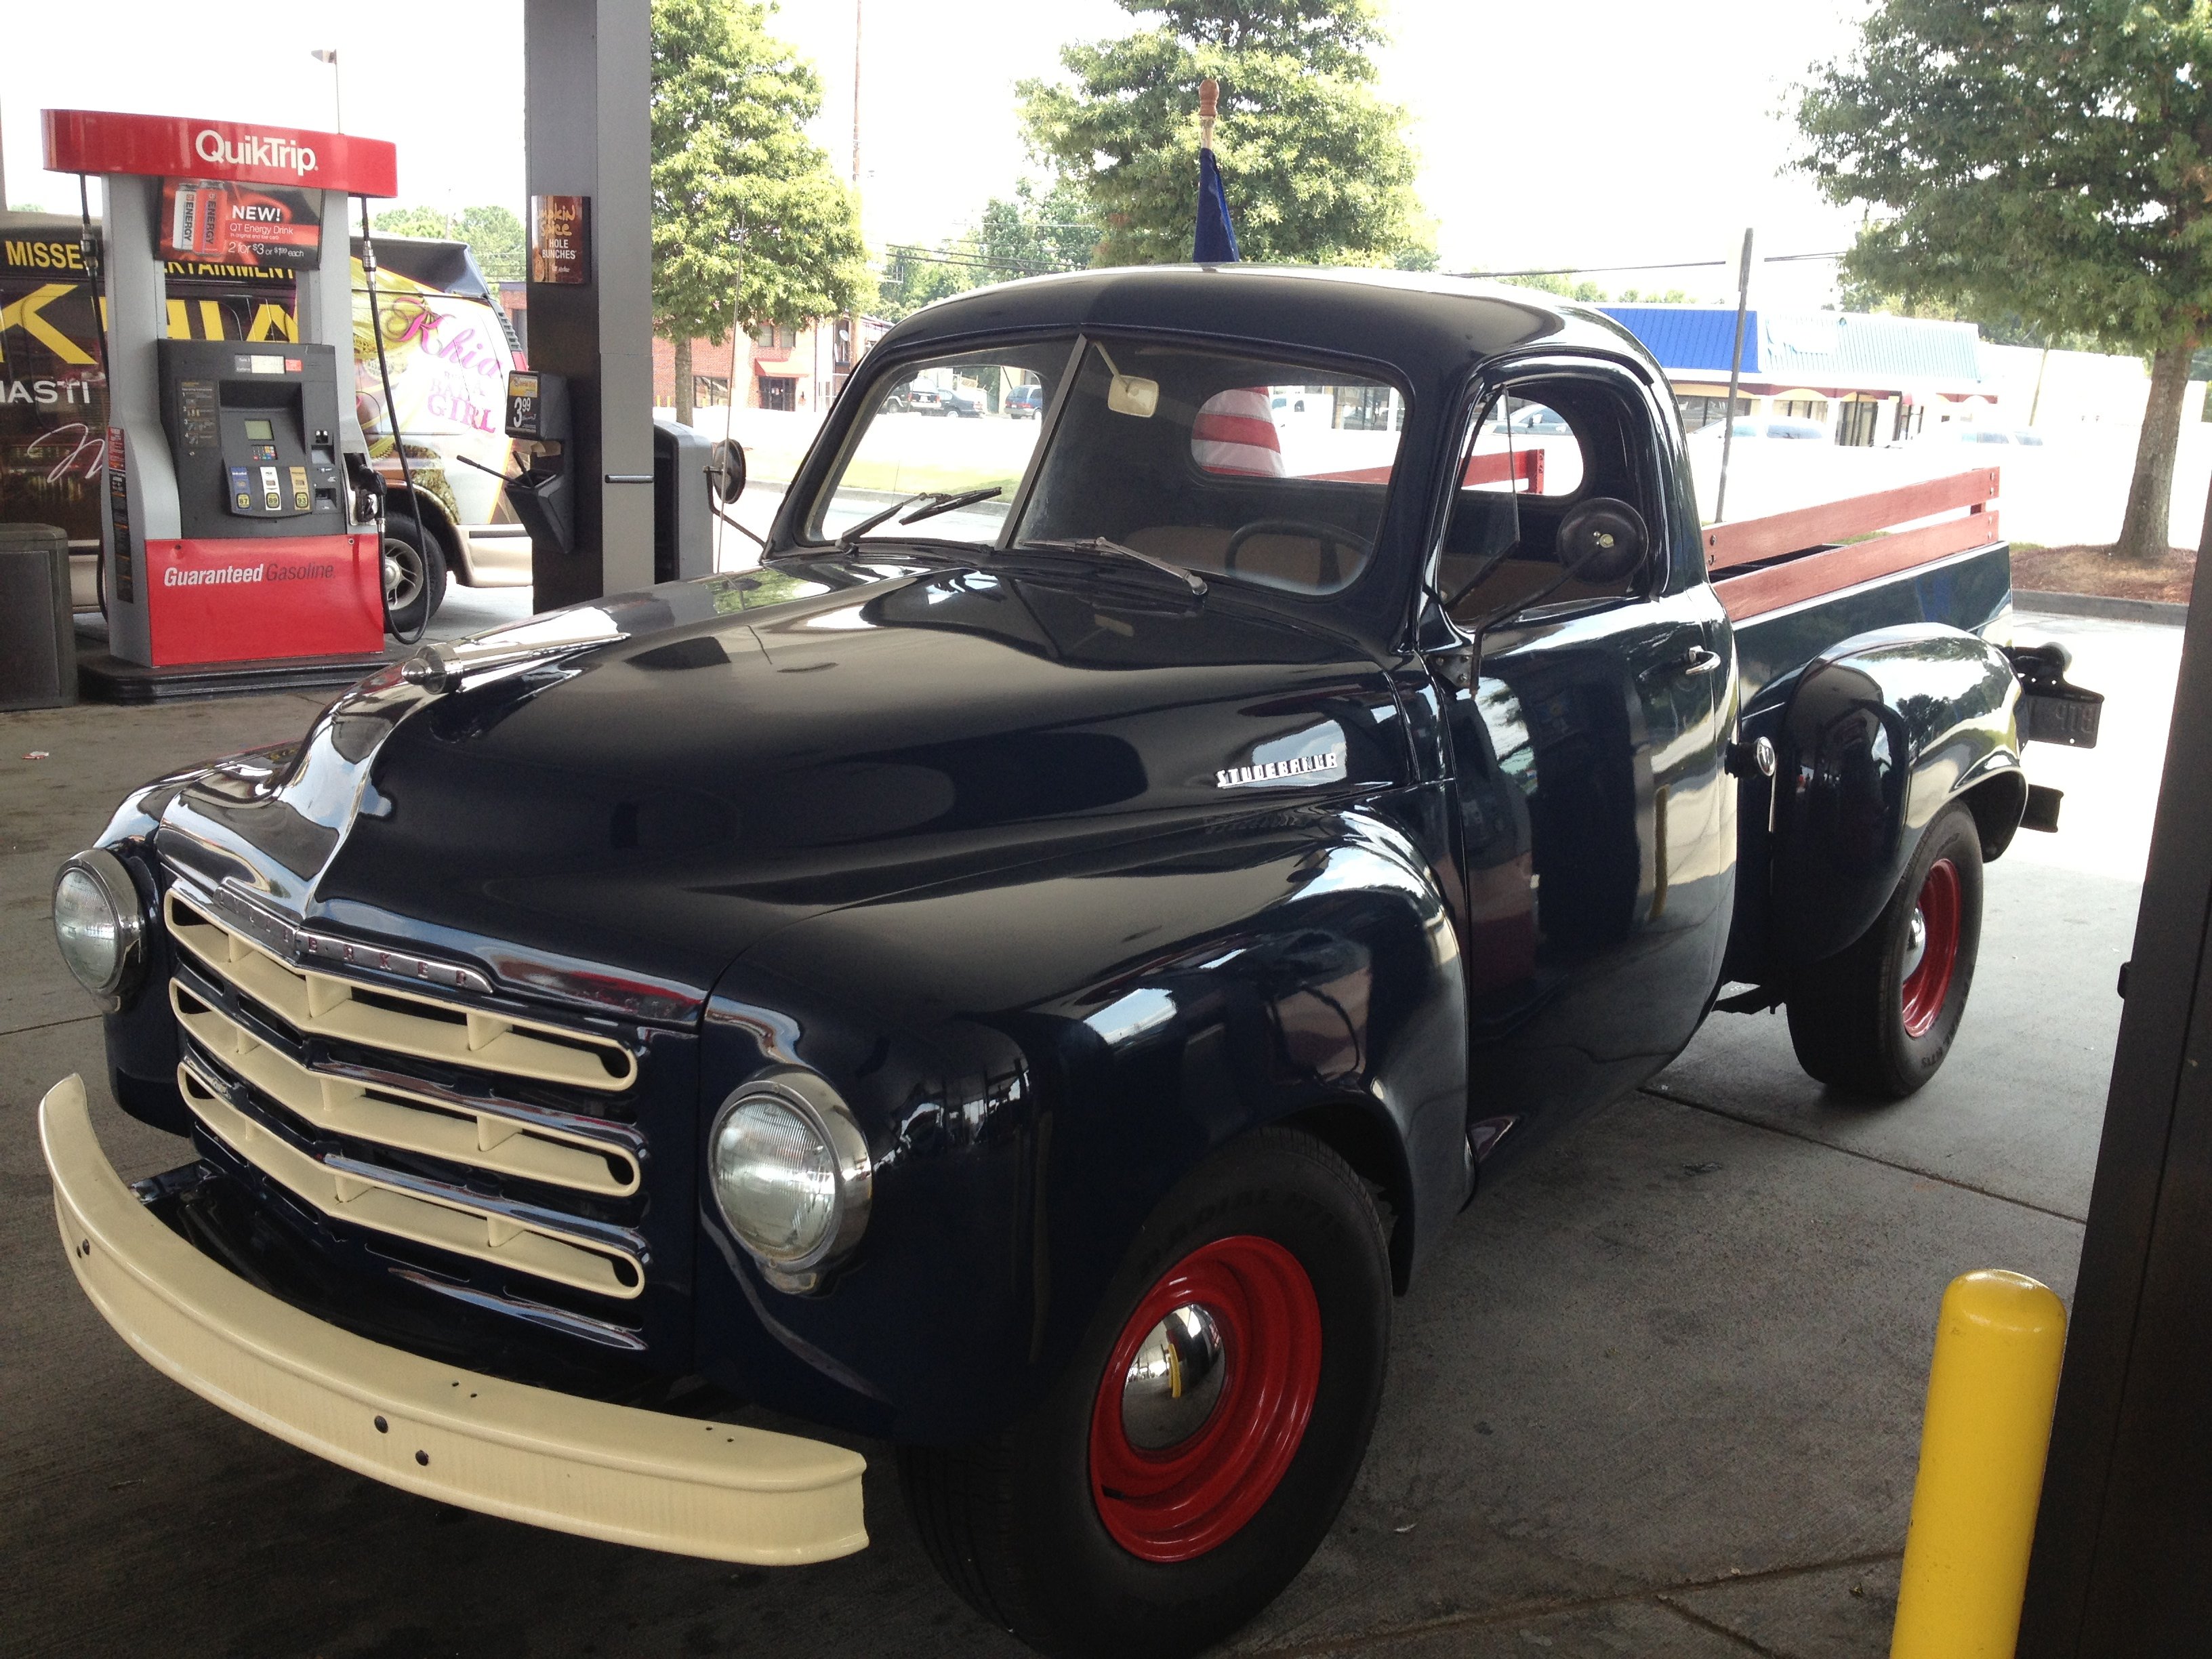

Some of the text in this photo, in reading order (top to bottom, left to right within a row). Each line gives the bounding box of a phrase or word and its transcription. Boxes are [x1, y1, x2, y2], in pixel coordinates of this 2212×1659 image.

[195, 129, 316, 176] QuikTrip
[184, 202, 194, 241] ENERGY
[206, 201, 216, 245] ENERGY
[232, 205, 281, 222] NEW!
[230, 222, 293, 235] QT Energy Drink
[228, 241, 236, 253] 2
[238, 242, 251, 253] for
[252, 243, 264, 255] $3
[549, 239, 569, 249] HOLE
[542, 249, 577, 260] BUNCHES
[0, 381, 90, 404] ASTI
[164, 562, 334, 586] Guaranteed Gasoline
